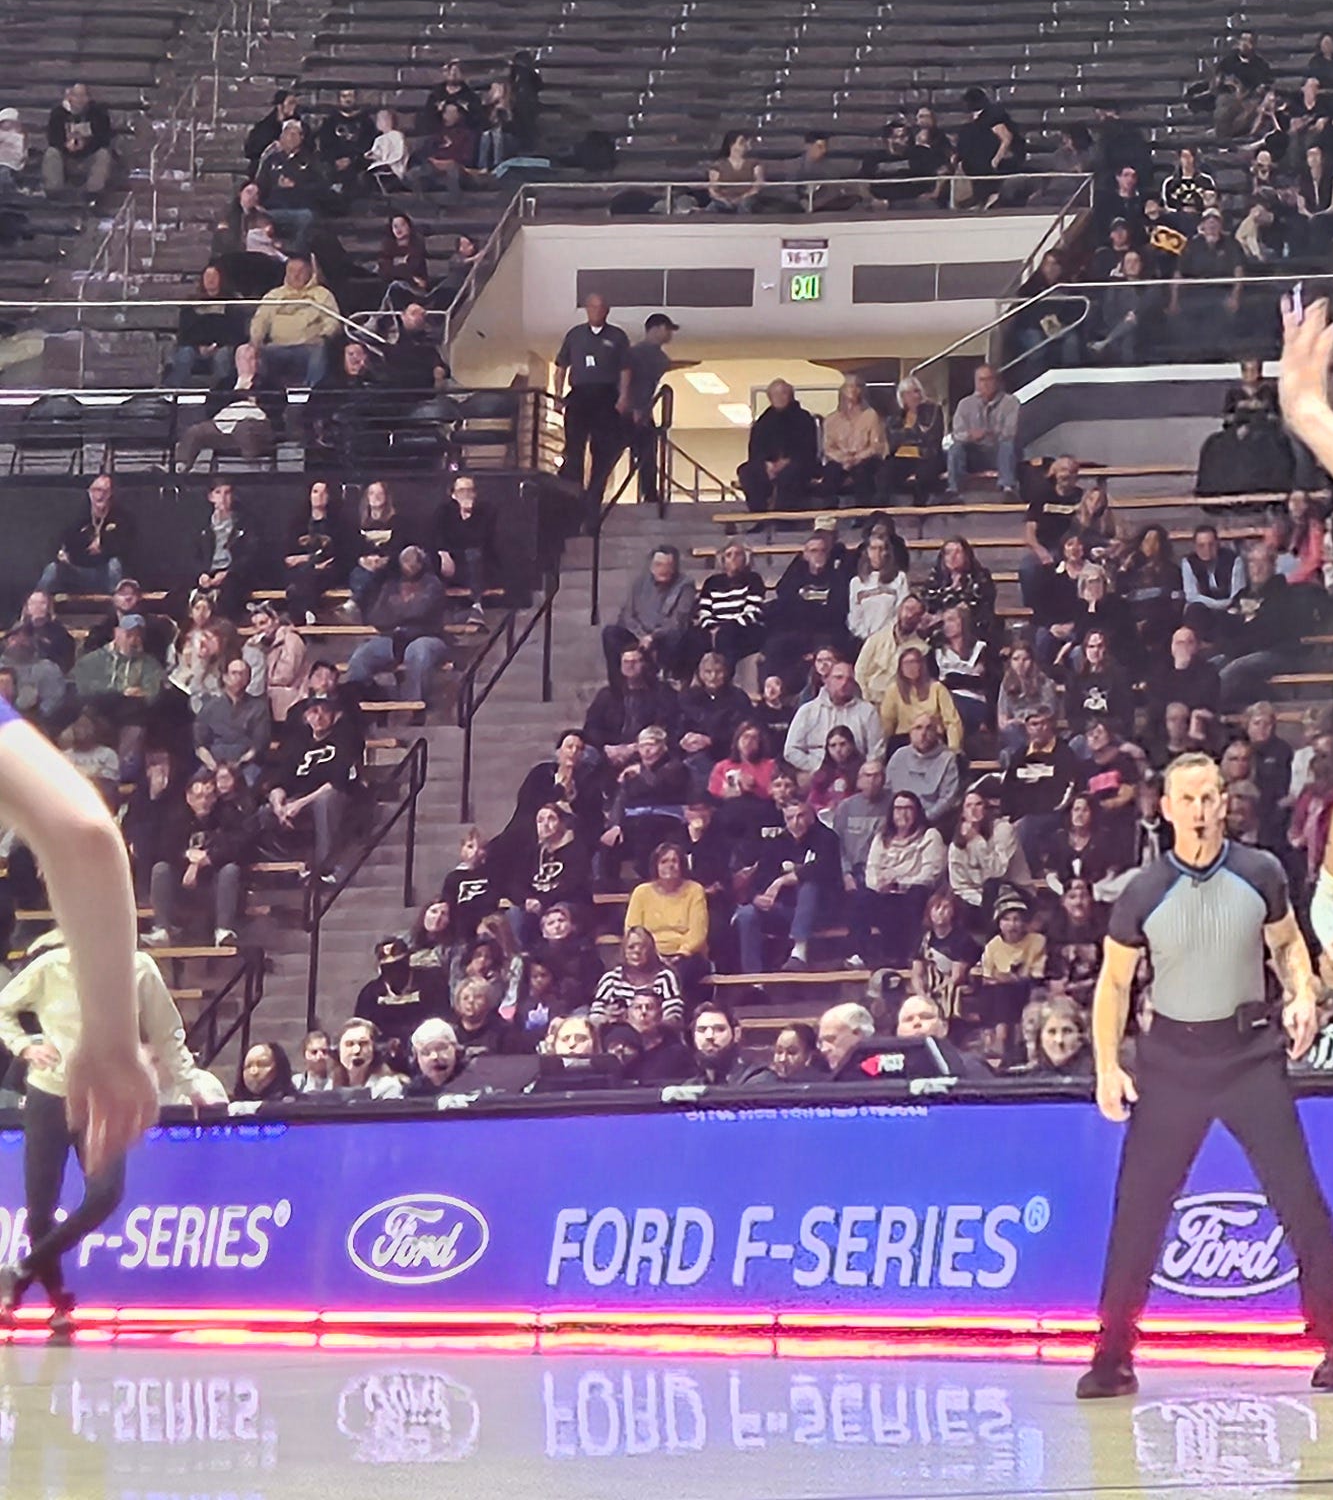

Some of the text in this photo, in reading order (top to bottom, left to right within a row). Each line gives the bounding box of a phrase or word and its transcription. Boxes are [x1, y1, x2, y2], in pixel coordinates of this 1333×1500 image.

[371, 1206, 463, 1269] Ford
[546, 1206, 715, 1287] FORD
[1163, 1203, 1284, 1283] Ford
